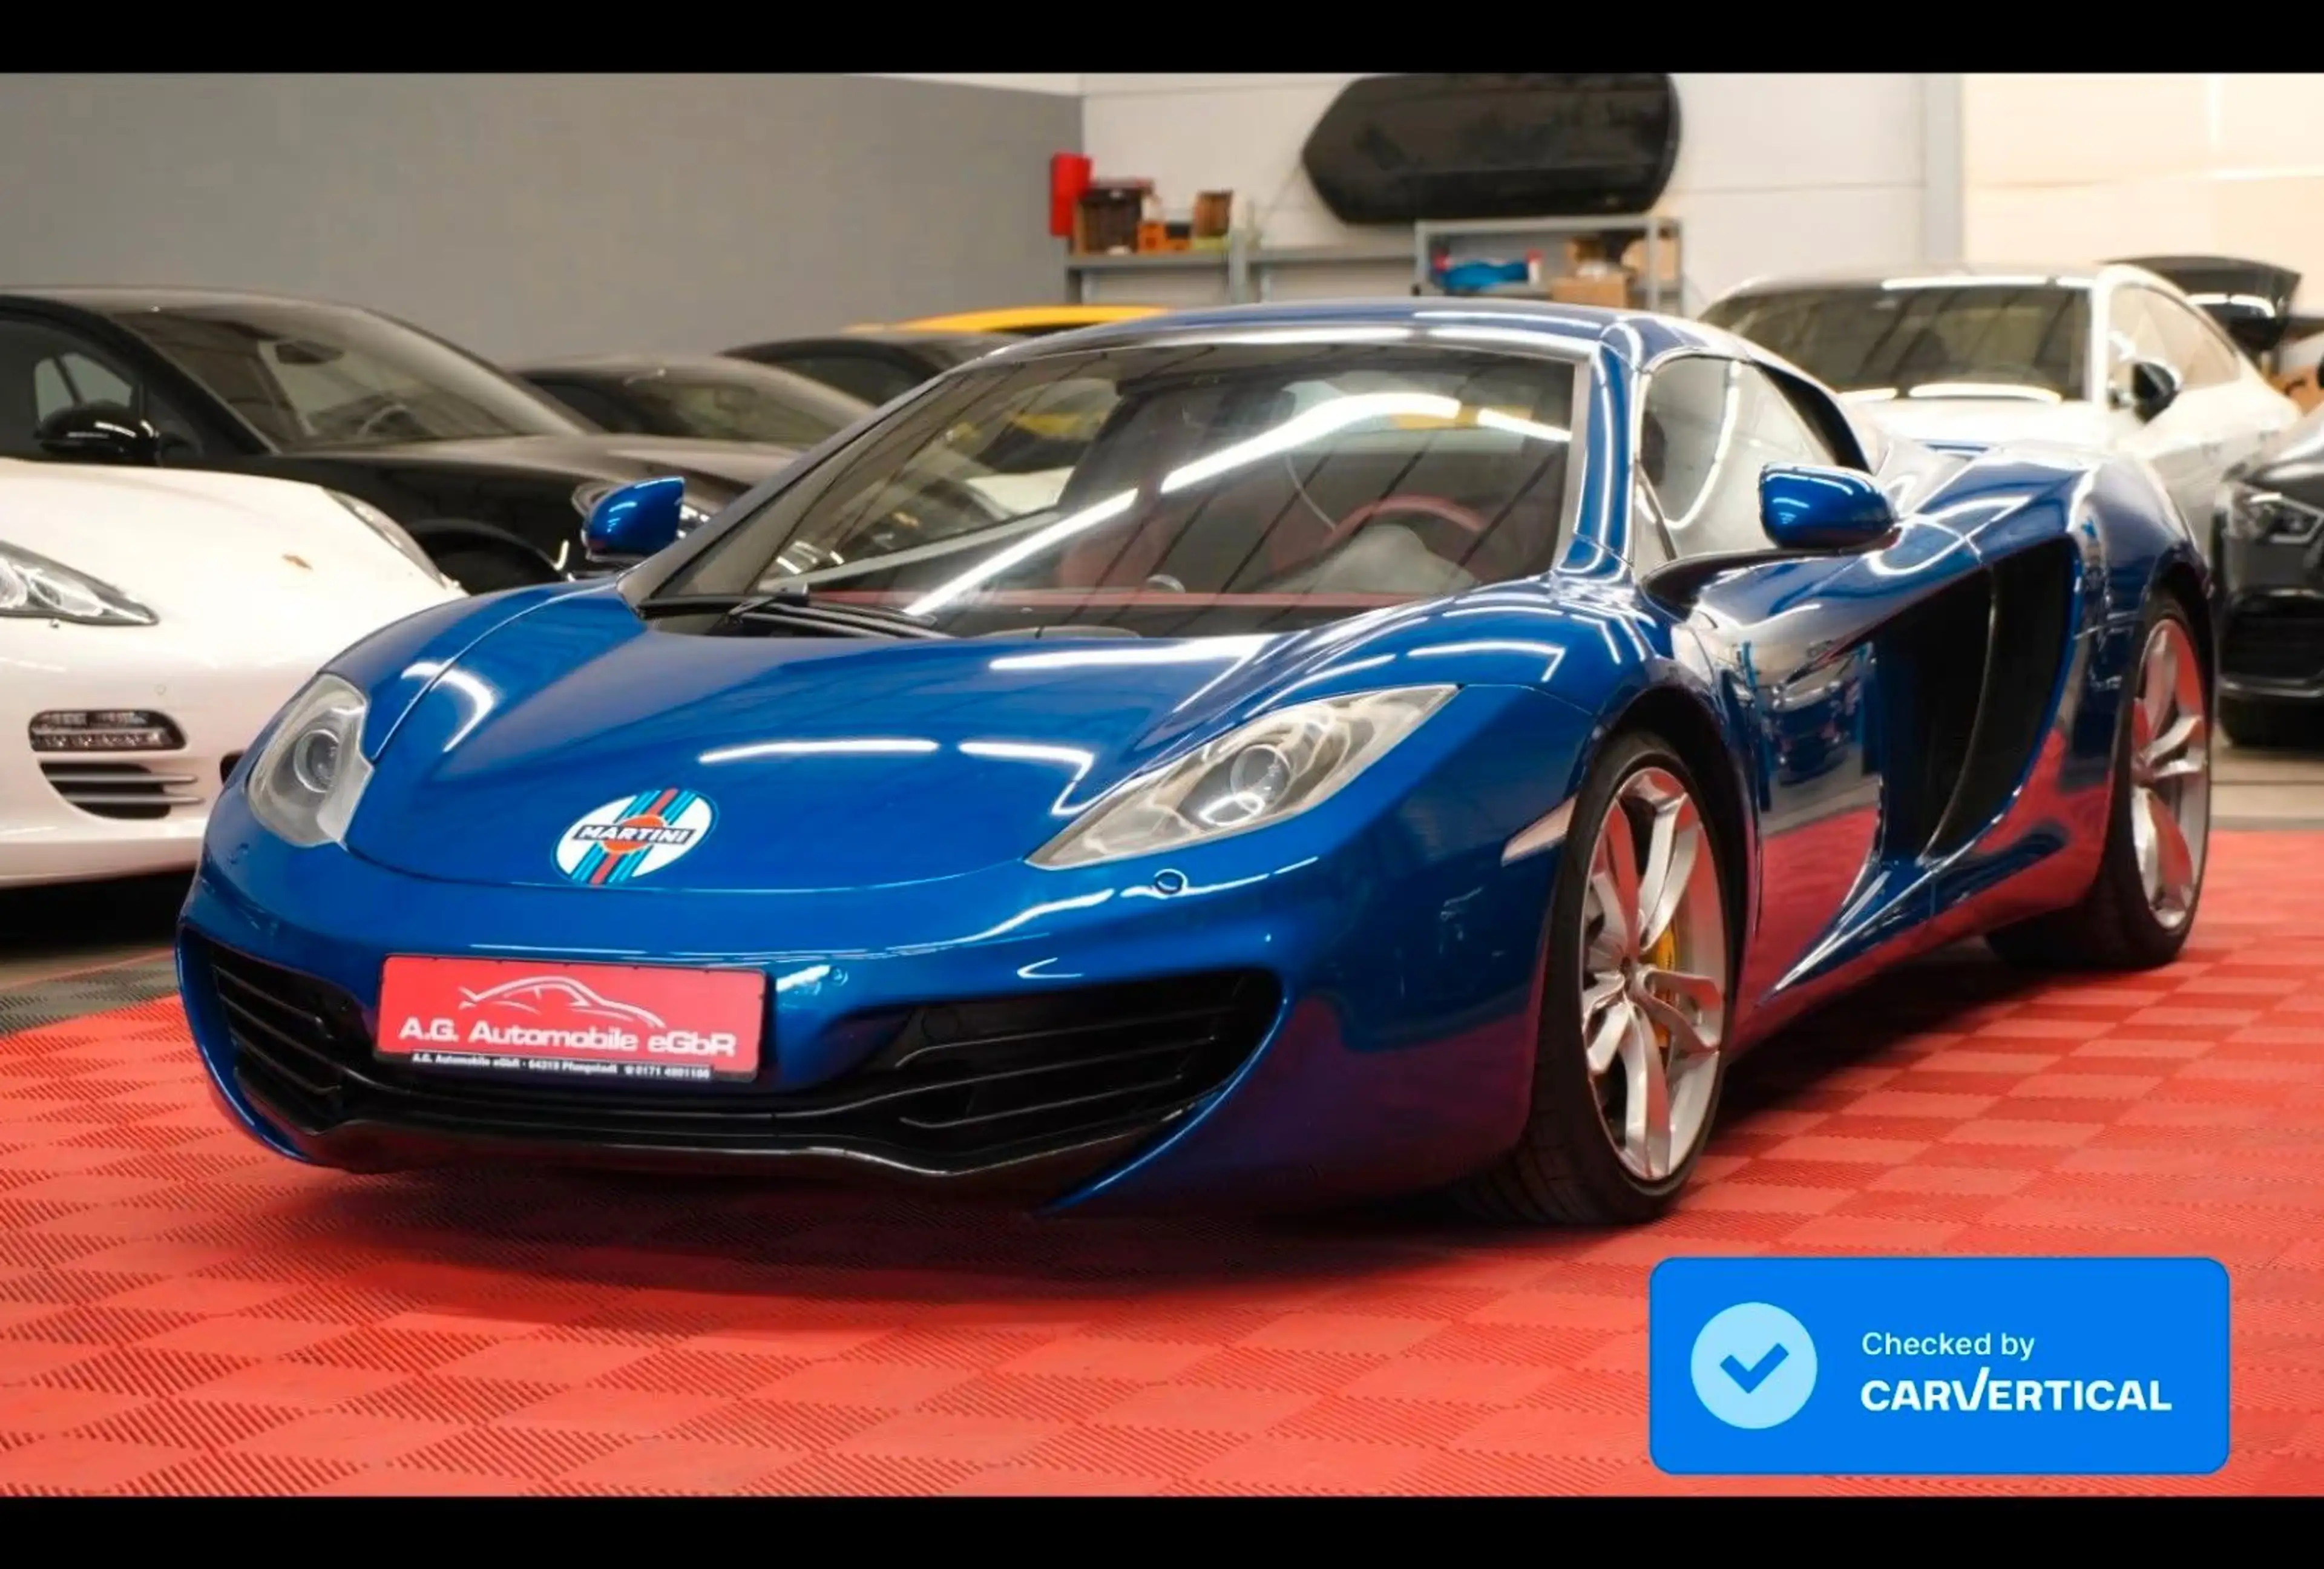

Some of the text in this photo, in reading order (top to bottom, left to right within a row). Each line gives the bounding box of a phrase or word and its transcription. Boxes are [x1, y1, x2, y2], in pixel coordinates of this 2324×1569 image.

[579, 827, 689, 842] MARTINI
[398, 1017, 736, 1057] A.G. Automobile eGbR
[436, 1054, 490, 1066] Automobile
